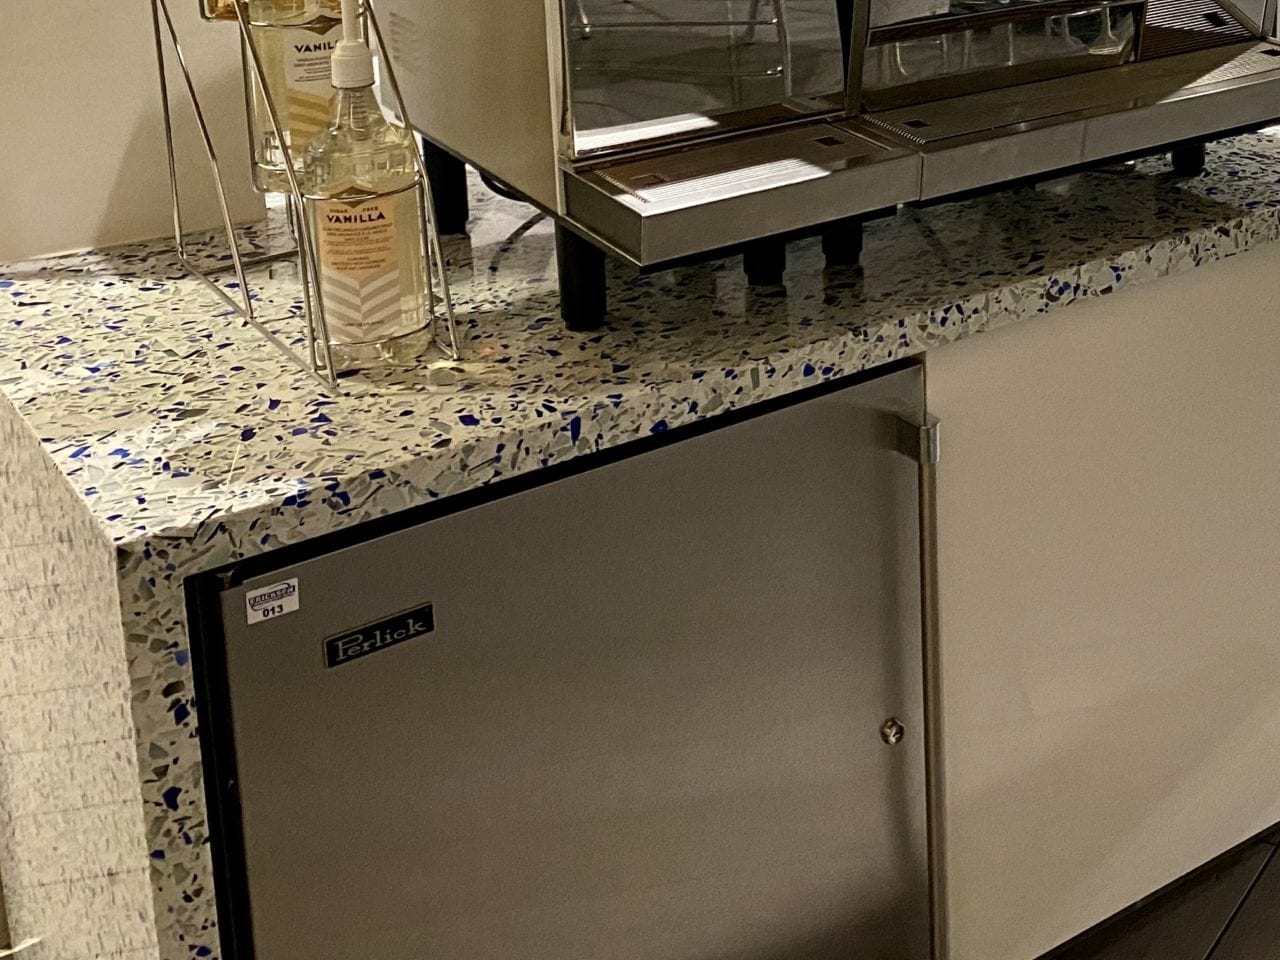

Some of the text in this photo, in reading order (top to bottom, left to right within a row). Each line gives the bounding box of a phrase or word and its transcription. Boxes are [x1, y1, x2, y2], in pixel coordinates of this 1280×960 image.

[293, 41, 339, 54] VANIL
[326, 211, 386, 225] VANILLA
[262, 604, 284, 618] 013
[333, 618, 427, 662] Perlick
